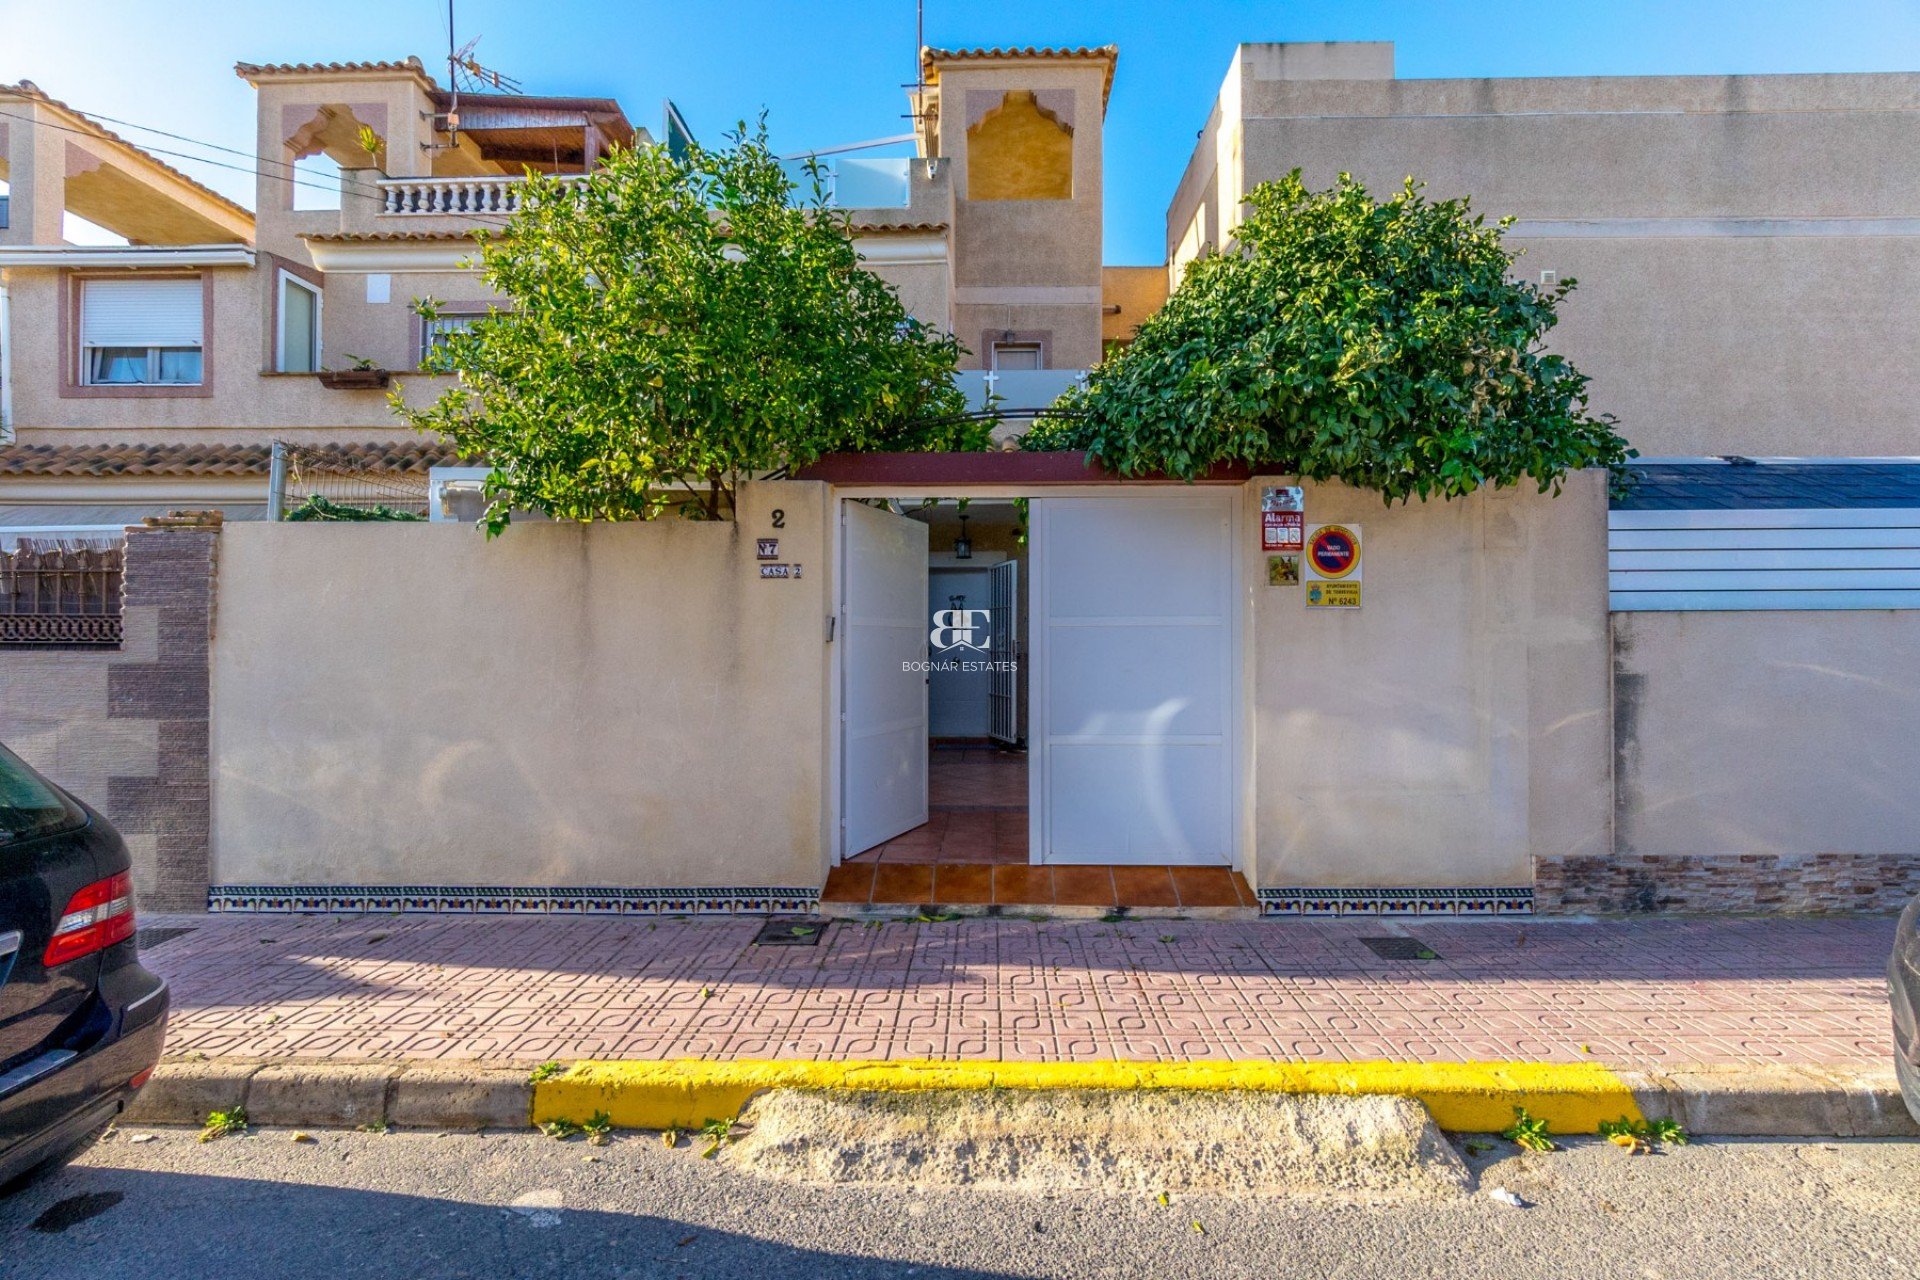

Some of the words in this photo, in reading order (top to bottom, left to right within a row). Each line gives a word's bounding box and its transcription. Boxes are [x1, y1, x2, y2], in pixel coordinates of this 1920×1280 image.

[771, 508, 786, 529] 2
[1265, 512, 1301, 522] Alarma
[761, 567, 788, 576] CASA
[795, 567, 801, 575] 2
